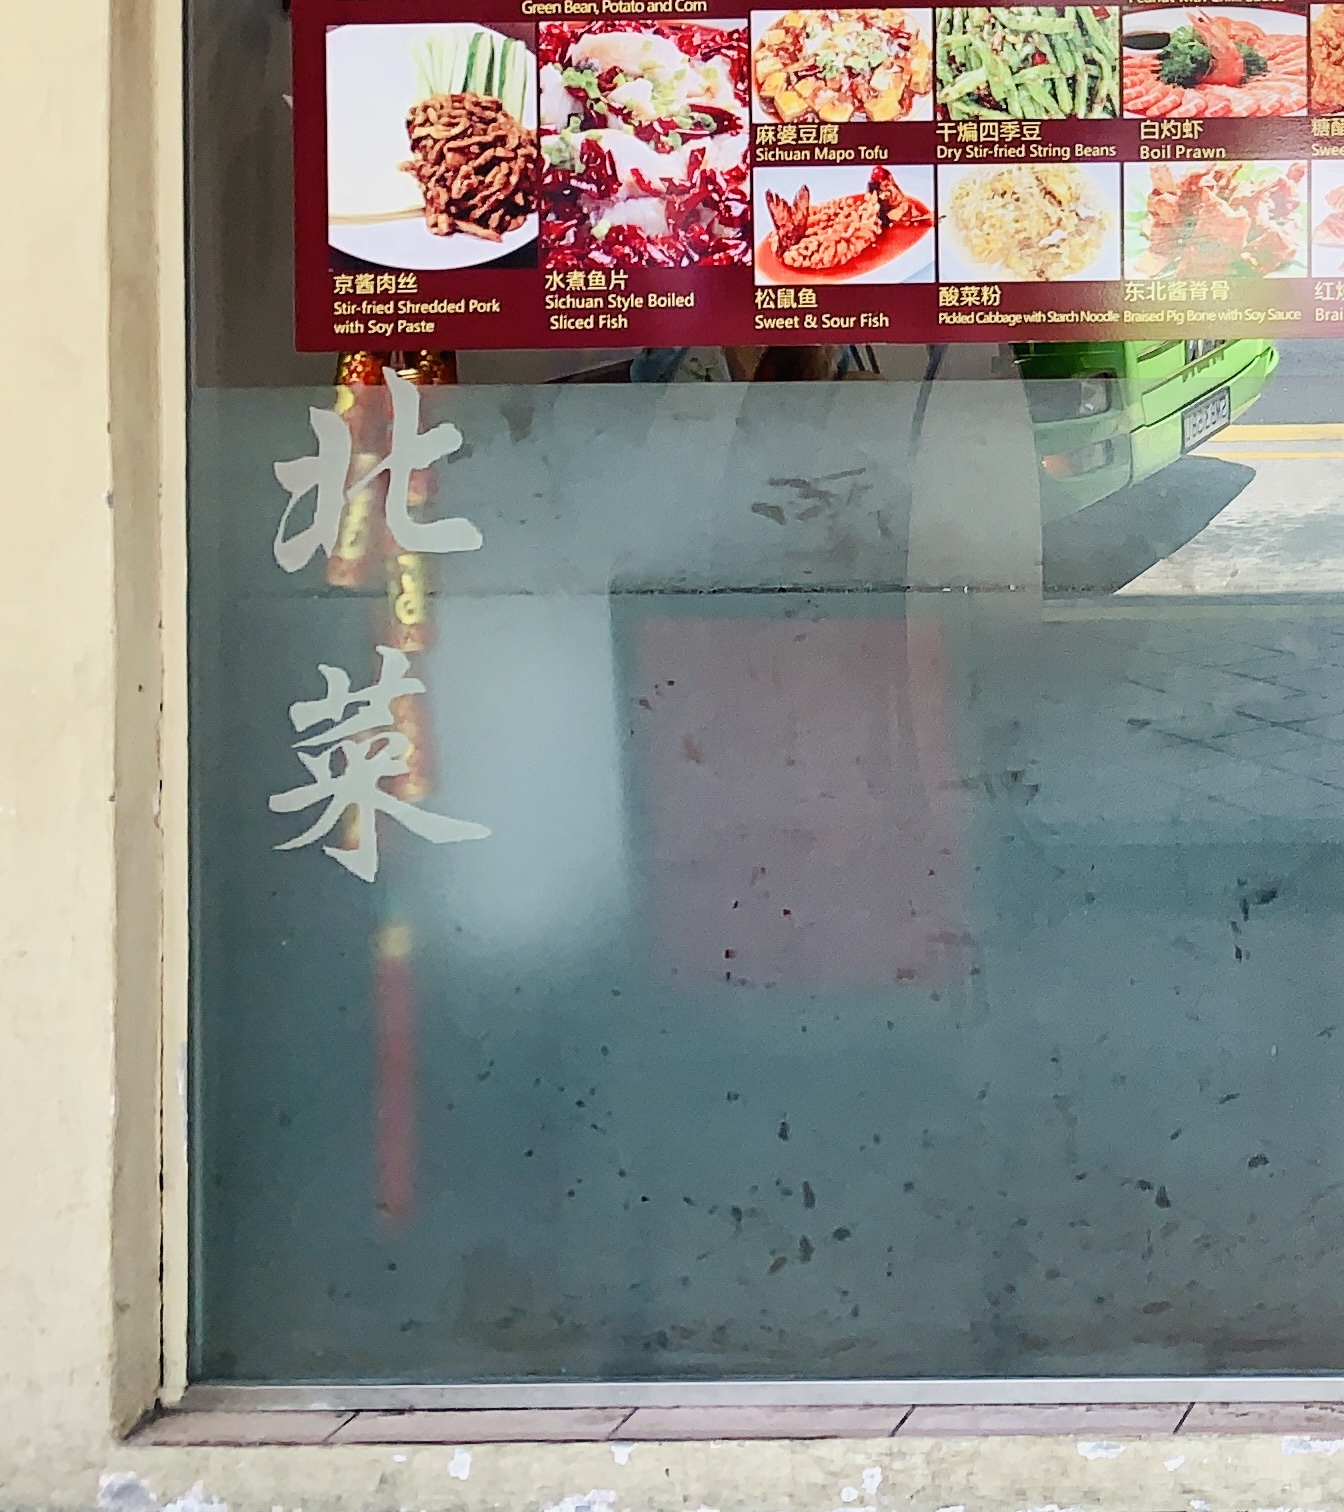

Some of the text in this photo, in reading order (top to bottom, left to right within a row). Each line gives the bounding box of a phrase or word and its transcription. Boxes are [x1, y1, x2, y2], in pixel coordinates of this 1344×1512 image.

[754, 123, 839, 145] 麻婆豆腐
[1140, 119, 1203, 140] 白灼虾
[756, 147, 888, 163] Sichuan Mapo Tofu
[1140, 145, 1227, 159] Boil Prawn
[333, 273, 418, 295] 京酱肉丝
[545, 269, 628, 291] 水煮鱼片
[755, 288, 818, 309] 松鼠鱼
[939, 285, 1001, 307] 酸菜粉
